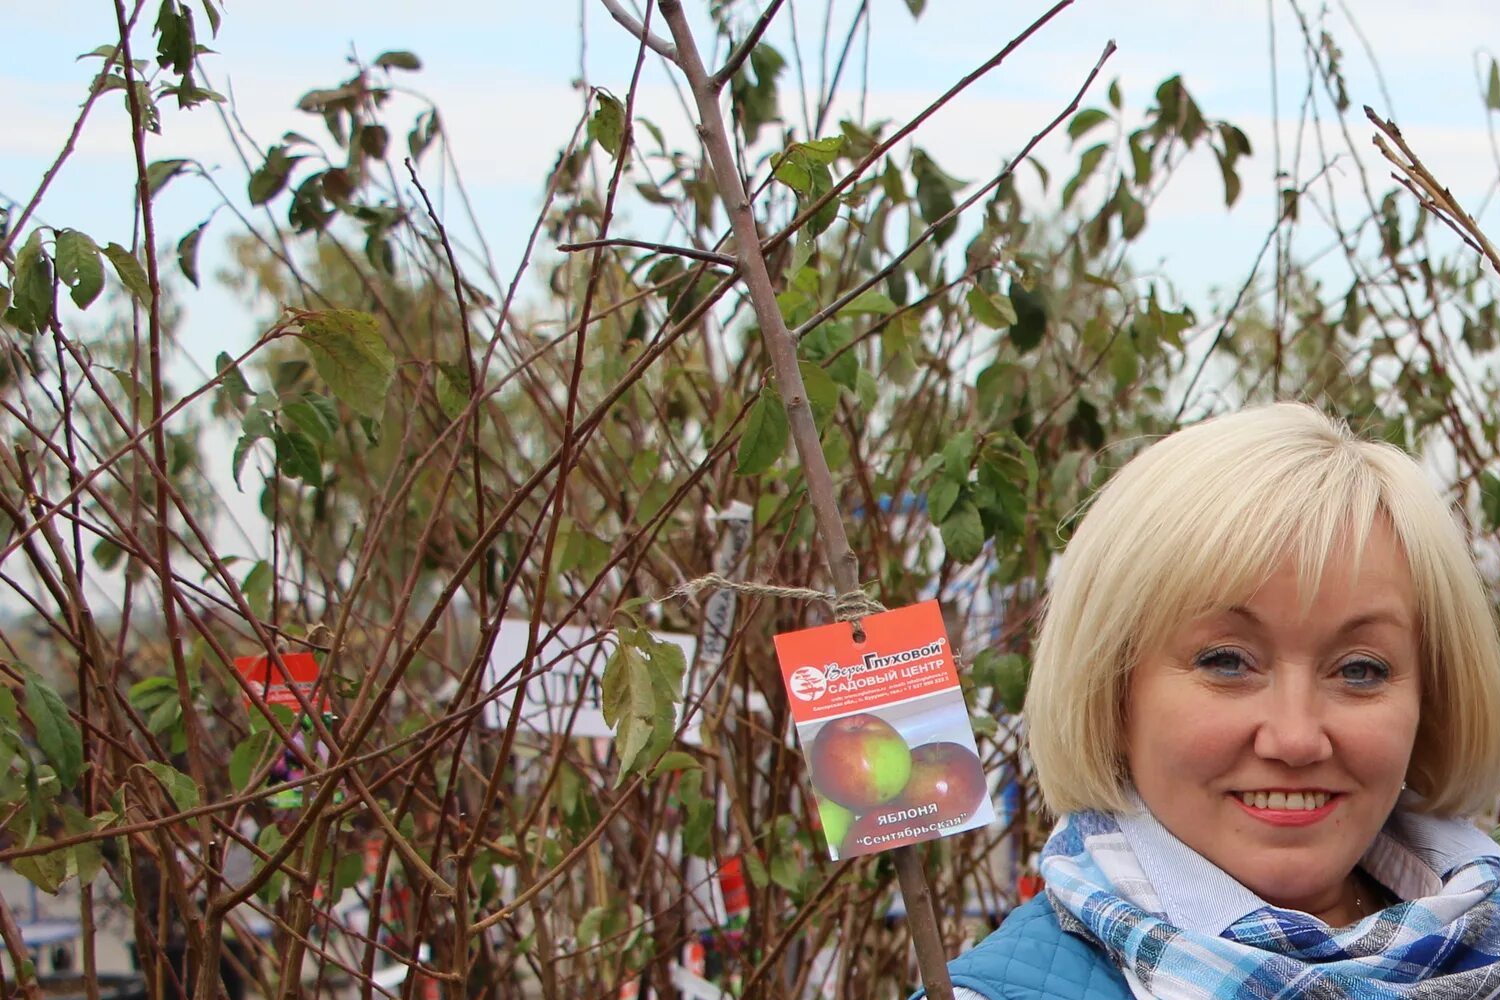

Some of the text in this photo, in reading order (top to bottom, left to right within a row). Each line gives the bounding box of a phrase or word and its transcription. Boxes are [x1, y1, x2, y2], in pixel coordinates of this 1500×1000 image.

[825, 664, 865, 681] Вери
[829, 660, 944, 693] САДОВЫЙ ЦЕНТР
[877, 803, 938, 825] ЯБЛОНЯ
